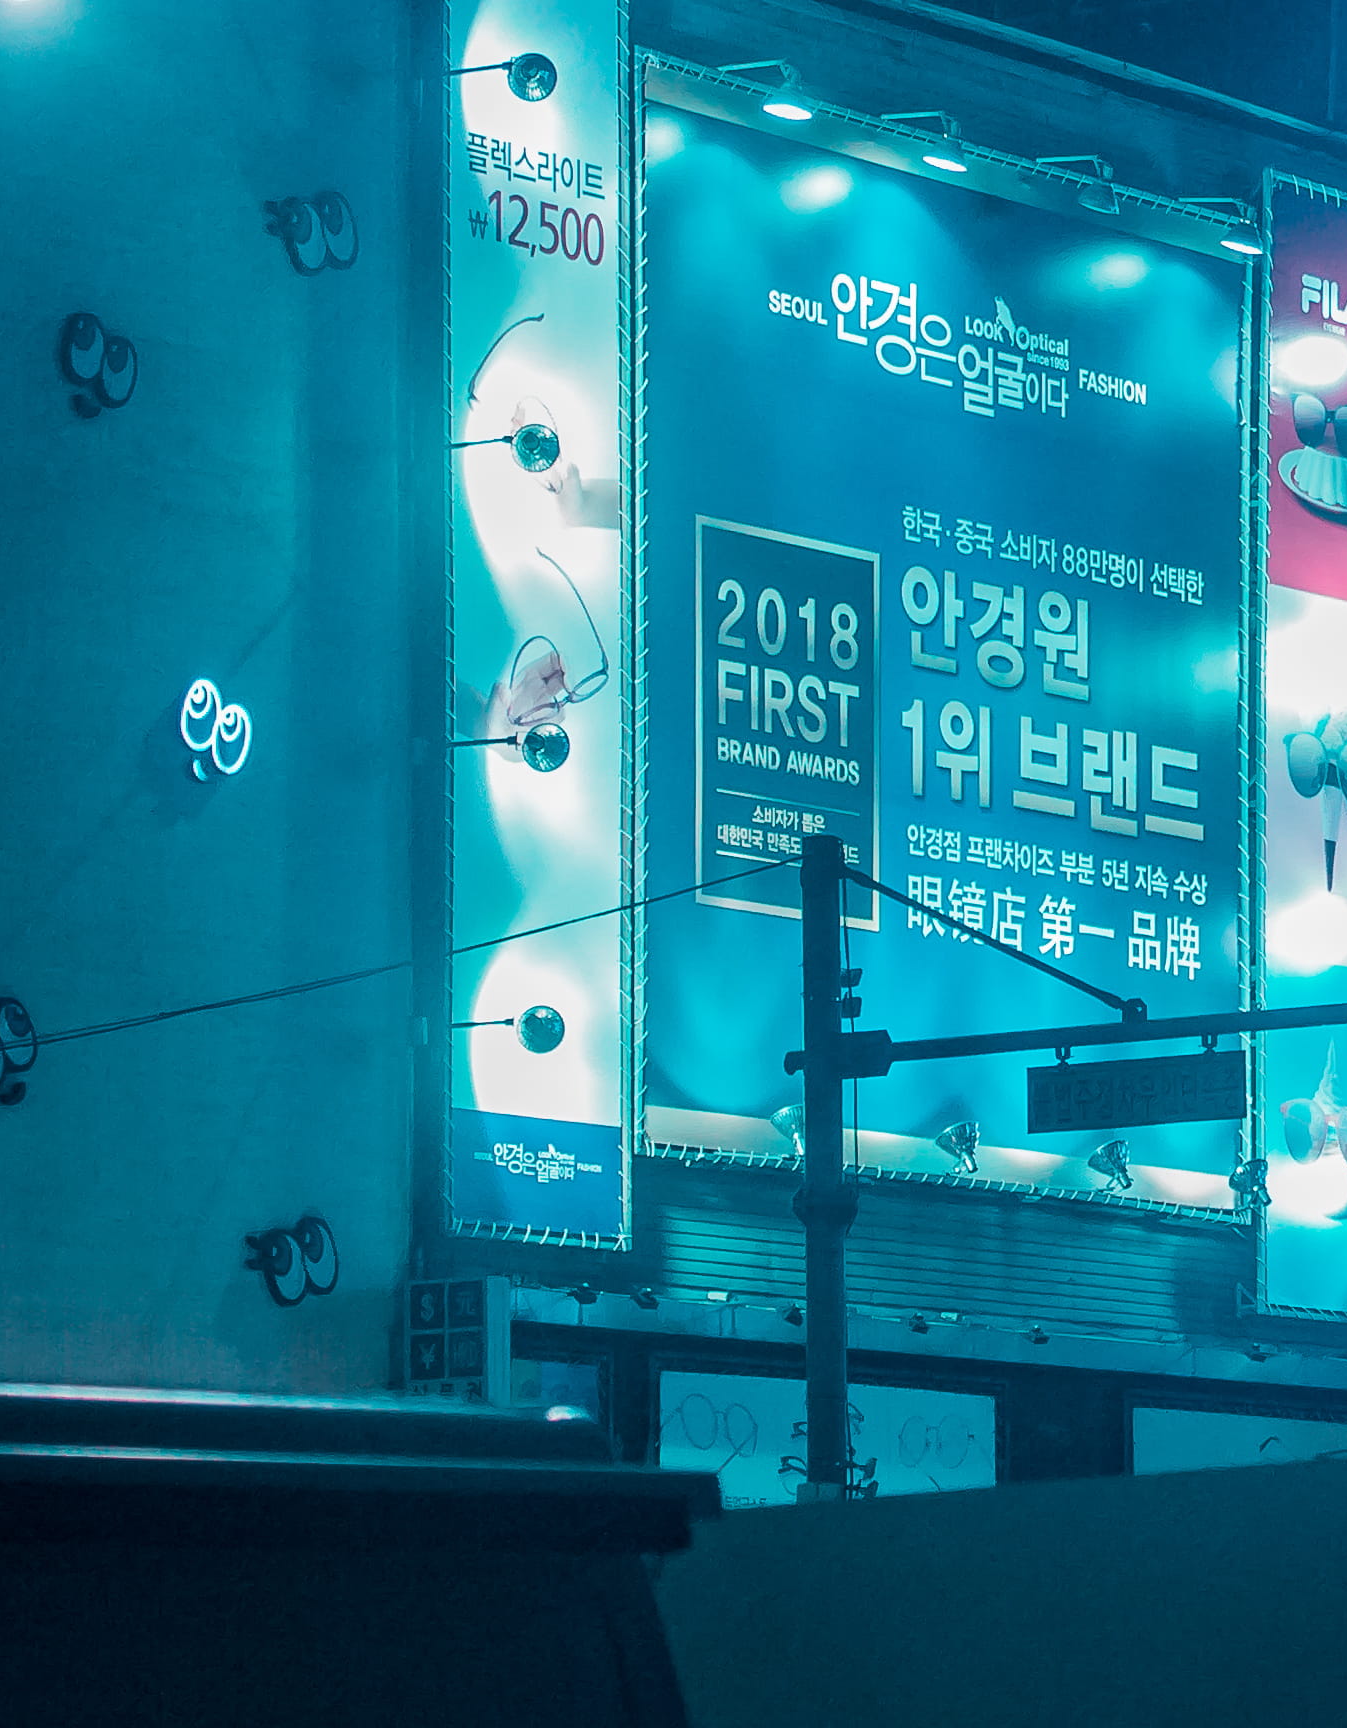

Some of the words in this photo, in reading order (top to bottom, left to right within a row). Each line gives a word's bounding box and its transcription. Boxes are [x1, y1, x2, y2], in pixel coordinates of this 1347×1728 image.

[465, 131, 607, 201] 플렉스라이트
[767, 288, 829, 327] SEOUL
[964, 314, 1005, 344] LOOK
[1015, 325, 1070, 358] Optical
[830, 272, 957, 390] 안경은
[957, 343, 1071, 420] 얼굴이다
[1078, 367, 1148, 406] FASHION
[999, 529, 1059, 573] 소비자
[1062, 543, 1144, 593] 88만명이
[1149, 561, 1205, 606] 선택한
[717, 578, 860, 671] 2018
[901, 565, 1091, 702] 안경원
[717, 658, 861, 749] FIRST
[717, 735, 781, 771] BRAND
[786, 749, 861, 786] AWARDS
[901, 698, 992, 809] 1위
[1012, 715, 1206, 842] 브랜드
[717, 823, 765, 851] 대한민국
[767, 832, 803, 855] 만족도
[752, 804, 800, 832] 소비자가
[907, 823, 962, 864] 안경점
[966, 835, 1055, 877] 프랜차이즈
[1059, 849, 1096, 886] 부분
[1101, 858, 1130, 892] 5년
[1135, 863, 1170, 900] 지속
[1173, 870, 1209, 906] 수상
[906, 874, 1027, 953] 眼镜店
[1038, 893, 1116, 960] 第一
[1127, 909, 1203, 981] 品牌
[493, 1142, 536, 1176] 안경은
